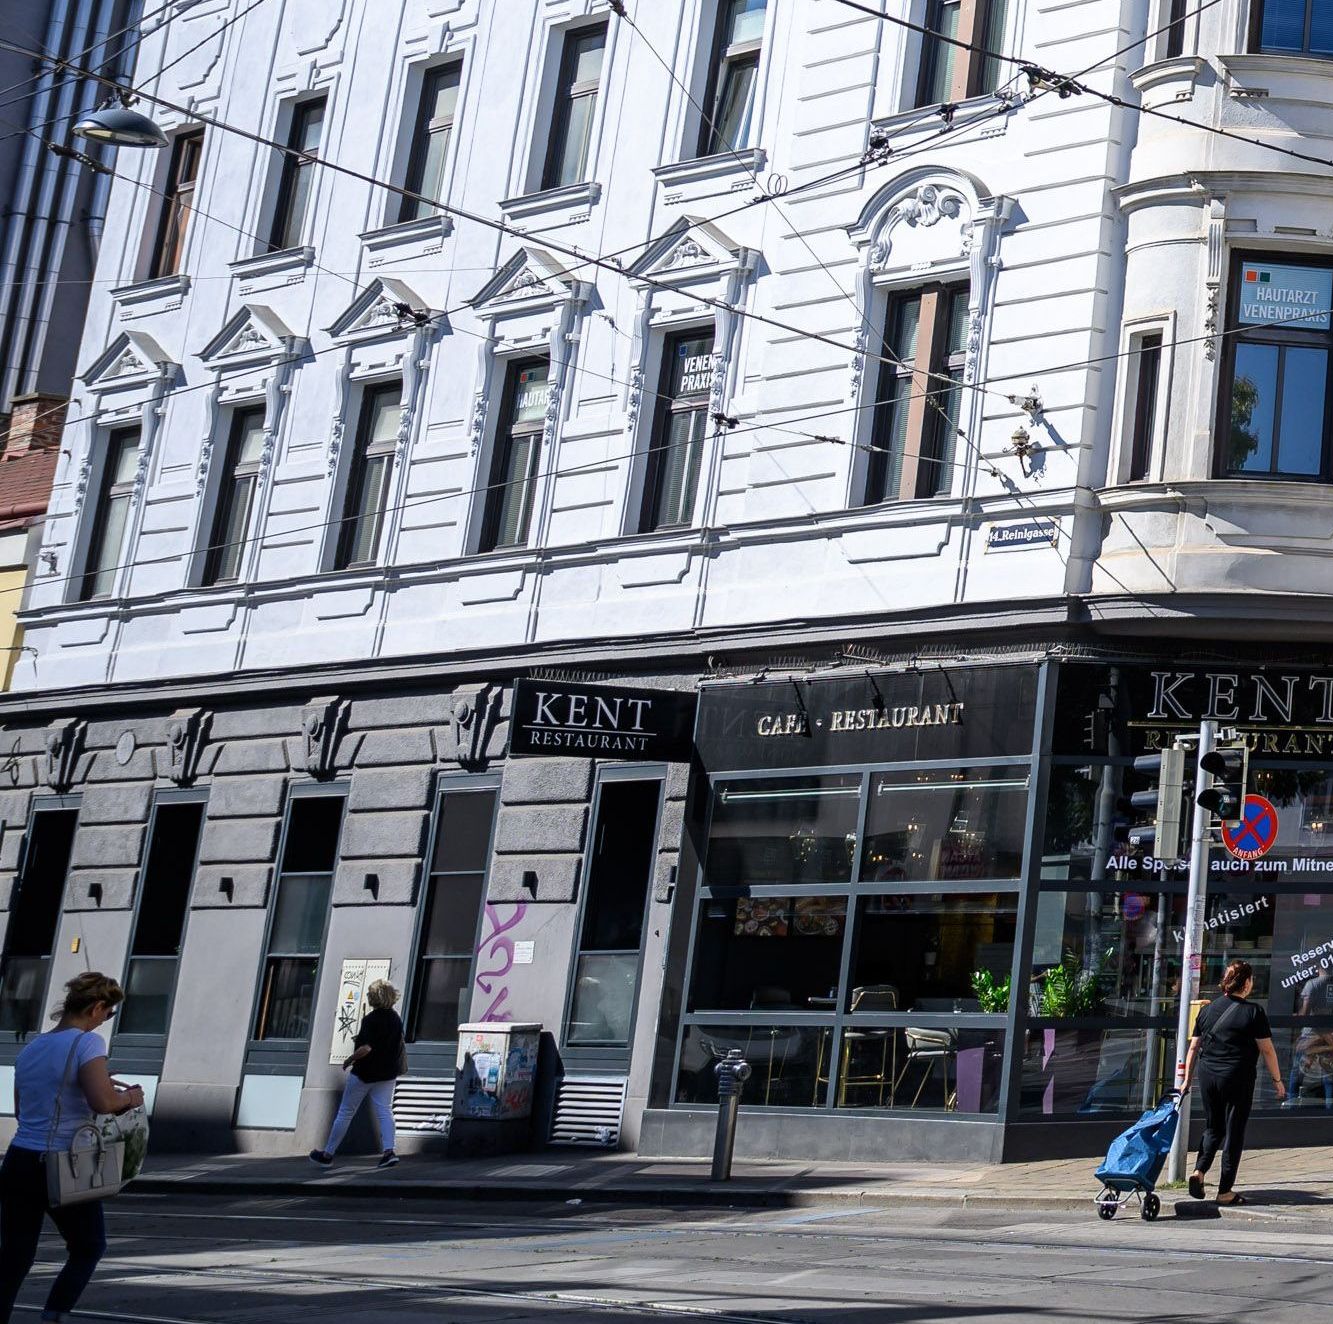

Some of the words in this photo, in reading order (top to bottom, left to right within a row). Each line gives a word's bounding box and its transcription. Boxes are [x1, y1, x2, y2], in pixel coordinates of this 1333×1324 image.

[1257, 287, 1319, 304] HAUTARZT
[1244, 304, 1328, 323] VENENPRAXIS
[1002, 528, 1054, 541] Reinlgasse
[531, 692, 652, 730] KENT
[830, 703, 964, 732] RESTAURANT
[530, 731, 649, 751] RESTAURANT
[1233, 847, 1263, 859] ANFANG
[1105, 855, 1137, 870] Alle
[1211, 858, 1250, 872] auch
[1254, 860, 1287, 872] zum
[1280, 963, 1320, 990] unter:
